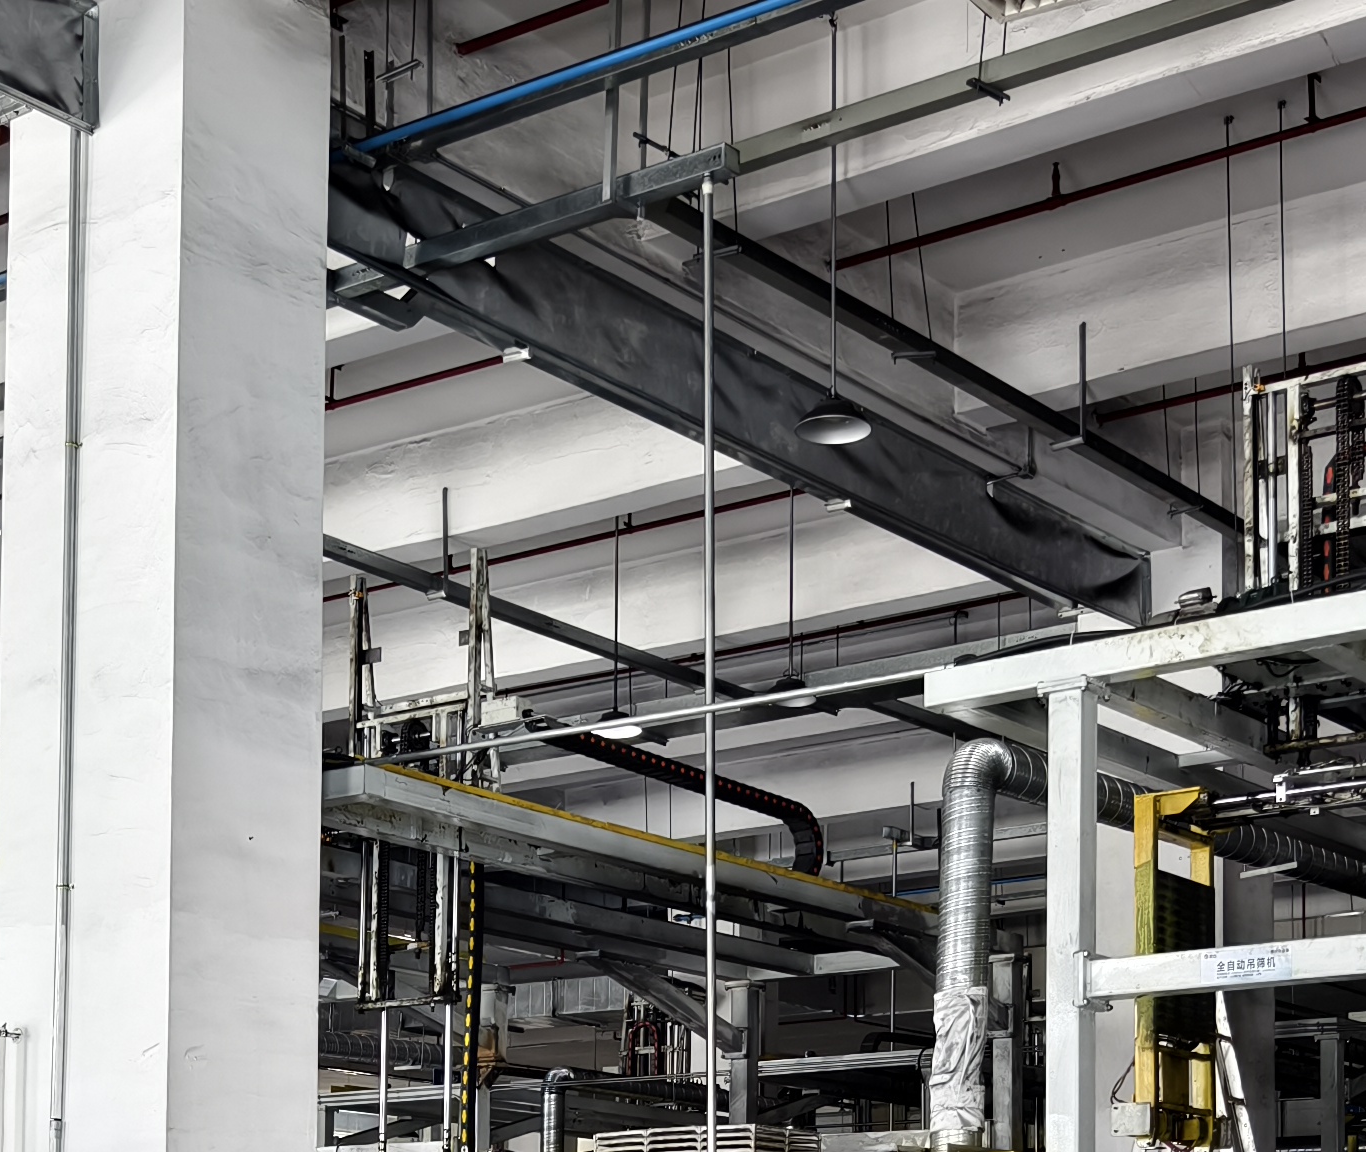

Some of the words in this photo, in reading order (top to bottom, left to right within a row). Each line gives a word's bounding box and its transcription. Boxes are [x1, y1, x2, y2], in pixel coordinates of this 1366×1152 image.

[1216, 957, 1276, 972] 全自动吊筛机
